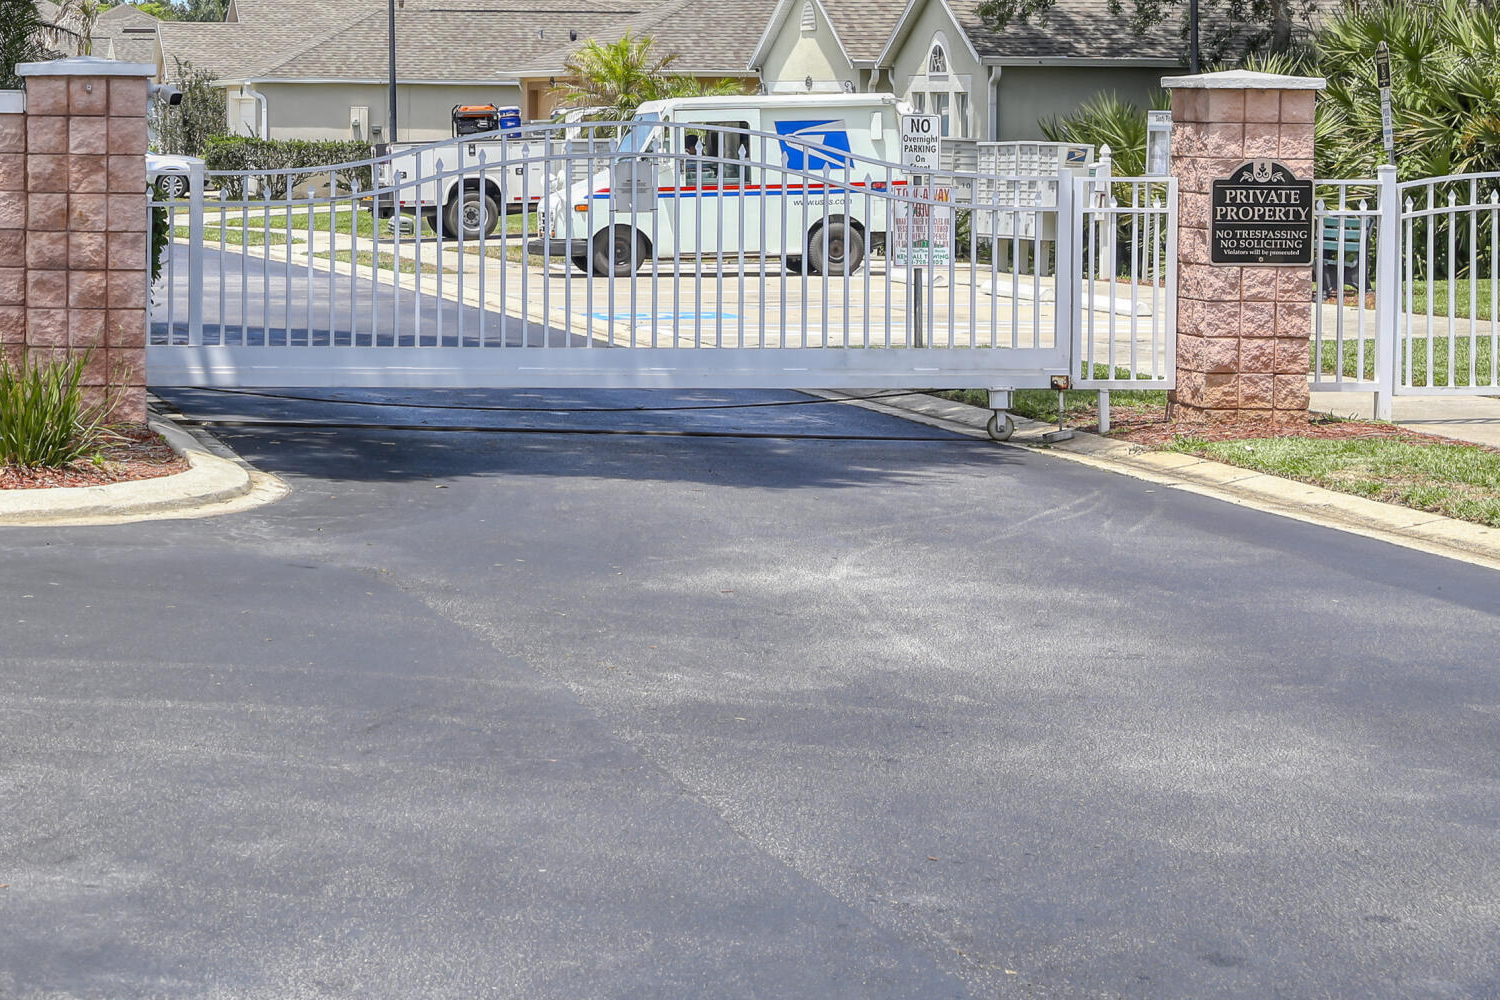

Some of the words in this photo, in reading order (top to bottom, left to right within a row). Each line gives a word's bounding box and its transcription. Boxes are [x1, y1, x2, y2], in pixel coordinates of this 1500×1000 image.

[910, 118, 931, 134] NO
[903, 134, 938, 145] Overnight
[904, 145, 937, 153] PARKING
[915, 154, 926, 163] On
[1224, 189, 1300, 204] PRIVATE
[793, 198, 853, 206] www.uss.co
[1215, 206, 1309, 221] PROPERTY
[1215, 230, 1232, 239] NO
[1235, 230, 1308, 239] TRESPASSING
[1220, 239, 1236, 248] NO
[1239, 239, 1303, 249] SOLICITING
